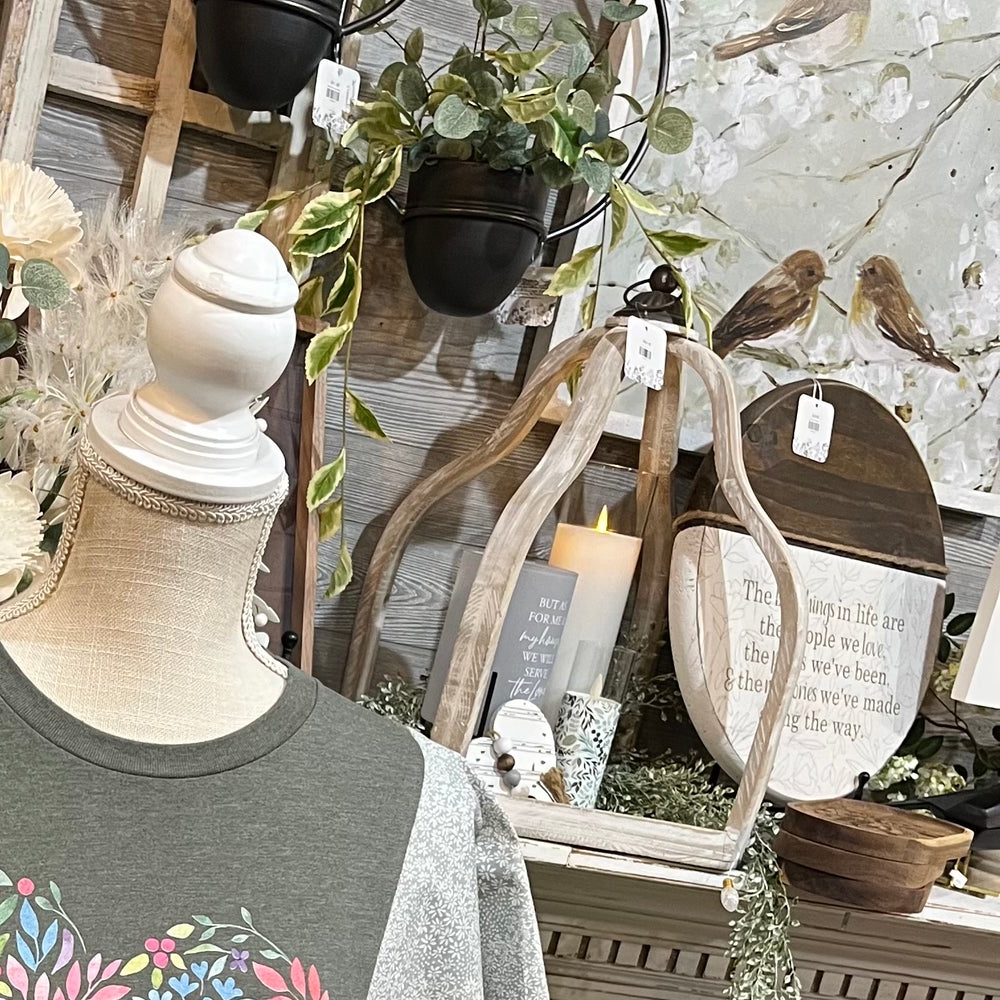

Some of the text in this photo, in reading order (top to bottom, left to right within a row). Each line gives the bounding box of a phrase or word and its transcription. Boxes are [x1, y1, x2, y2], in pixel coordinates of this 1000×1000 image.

[539, 597, 561, 610] BUT
[743, 578, 772, 606] The
[837, 599, 852, 622] in
[856, 603, 879, 628] life
[882, 615, 905, 632] are
[528, 611, 549, 625] FOR
[519, 630, 539, 650] my
[760, 615, 782, 639] the
[806, 626, 836, 650] ople
[840, 636, 860, 653] we
[522, 651, 539, 664] WE
[744, 641, 770, 666] the
[811, 658, 851, 680] we've
[854, 665, 891, 688] been.
[508, 677, 533, 699] the
[724, 667, 735, 693] &
[738, 669, 763, 694] the
[820, 688, 859, 709] we've
[862, 694, 901, 717] made
[804, 711, 829, 735] the
[832, 720, 864, 743] way.
